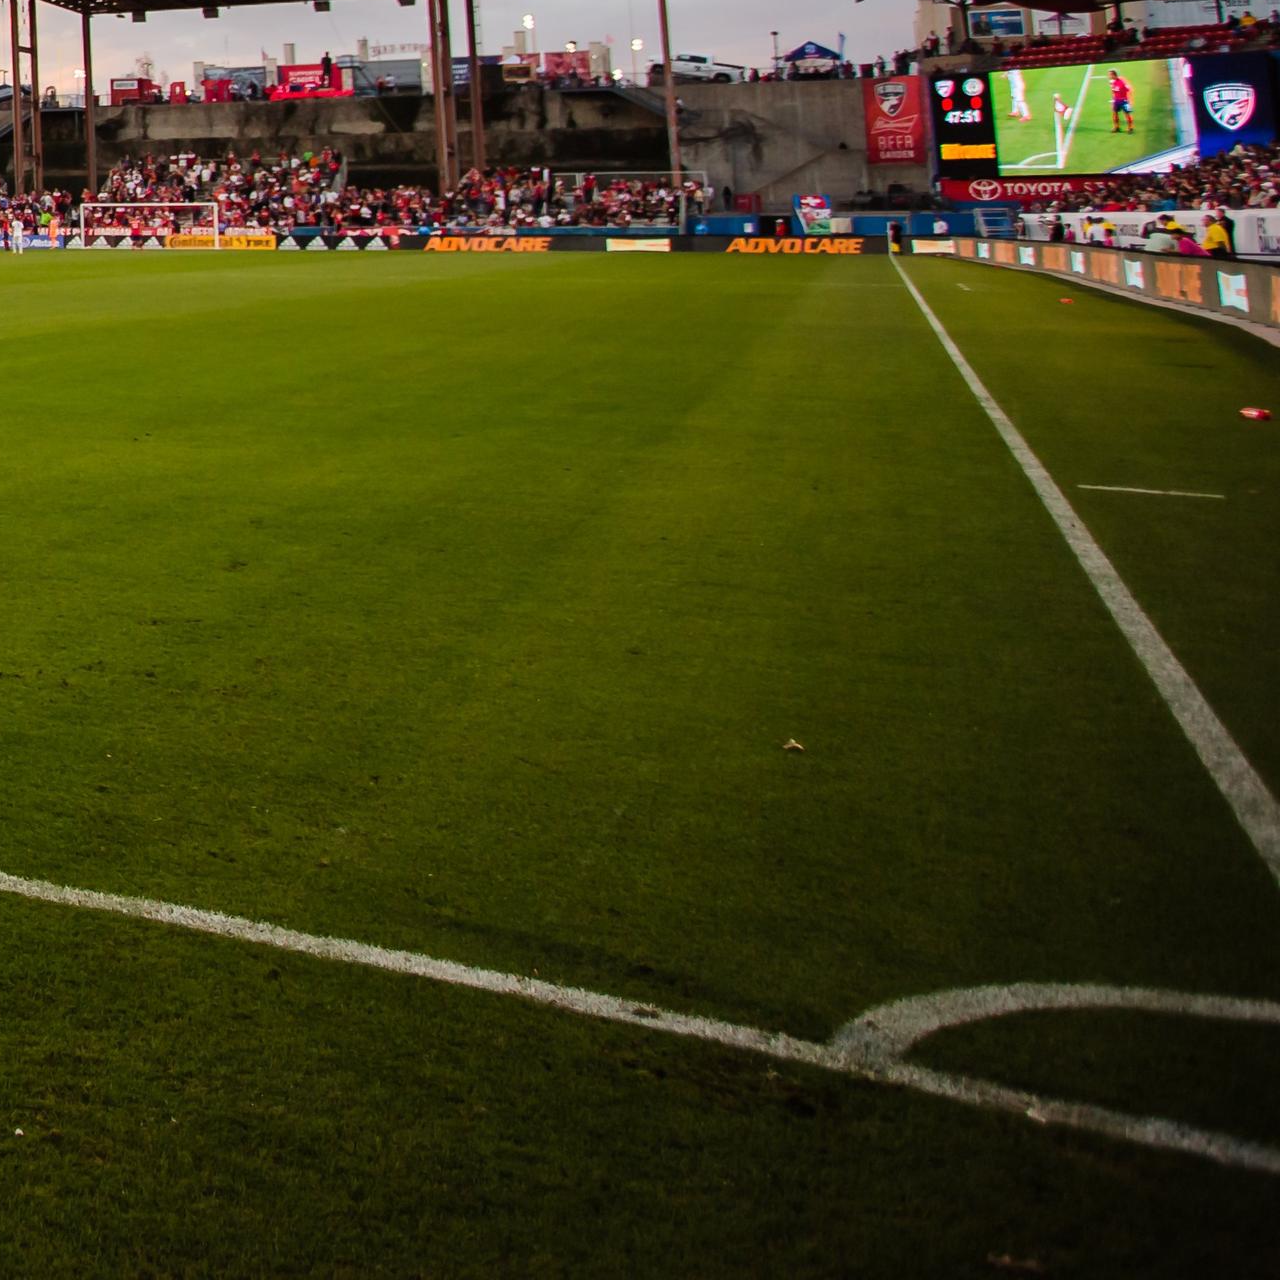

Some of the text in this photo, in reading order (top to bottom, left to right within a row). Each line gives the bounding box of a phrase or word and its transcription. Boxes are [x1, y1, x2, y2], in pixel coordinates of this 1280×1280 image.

[1003, 183, 1073, 196] TOYOTA
[246, 238, 272, 247] TIRE
[424, 237, 551, 252] ADVOCARE
[726, 238, 864, 254] ADVOCARE
